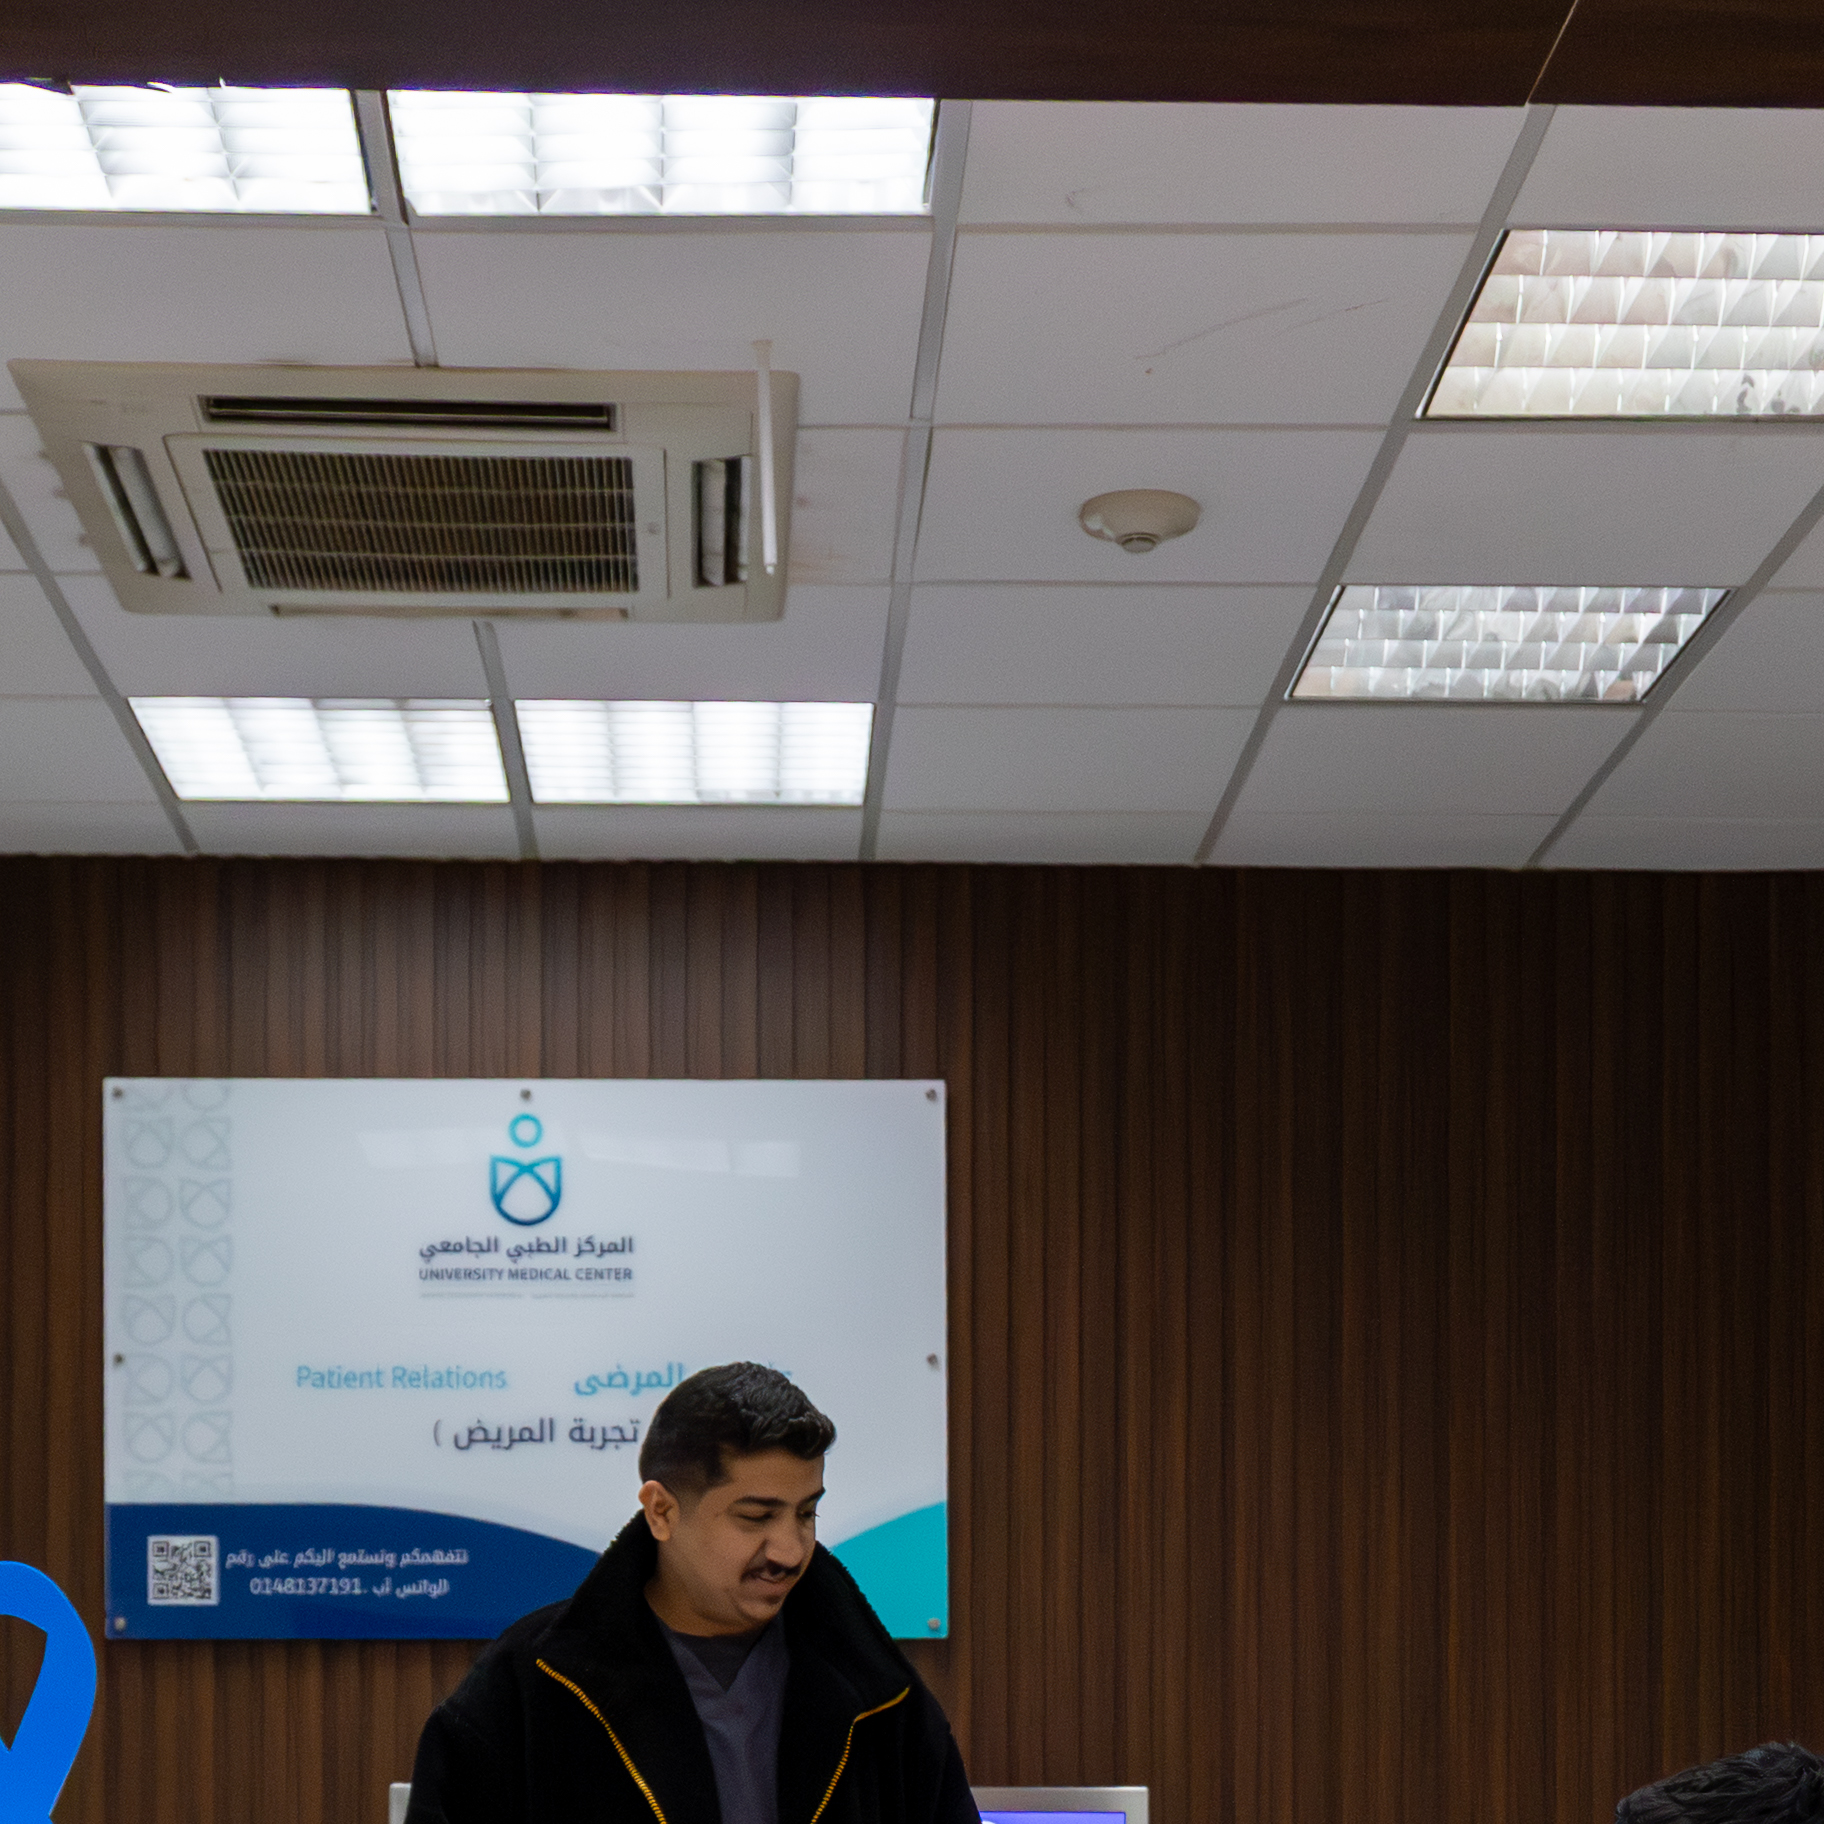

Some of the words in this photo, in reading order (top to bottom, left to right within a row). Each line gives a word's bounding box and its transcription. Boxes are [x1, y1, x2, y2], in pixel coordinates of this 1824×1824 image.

[419, 1235, 499, 1263] الجامعي
[506, 1235, 567, 1263] الطبي
[573, 1234, 634, 1258] المركز
[419, 1267, 503, 1281] UNIVERSITY
[508, 1267, 571, 1281] MEDICAL
[575, 1267, 633, 1281] CENTER
[296, 1364, 383, 1389] Patient
[391, 1363, 508, 1389] Relations
[453, 1417, 554, 1450] المريض
[569, 1418, 640, 1449] تجربة
[225, 1549, 255, 1569] رقم
[338, 1548, 397, 1570] ونستمع
[395, 1578, 451, 1599] الواتس
